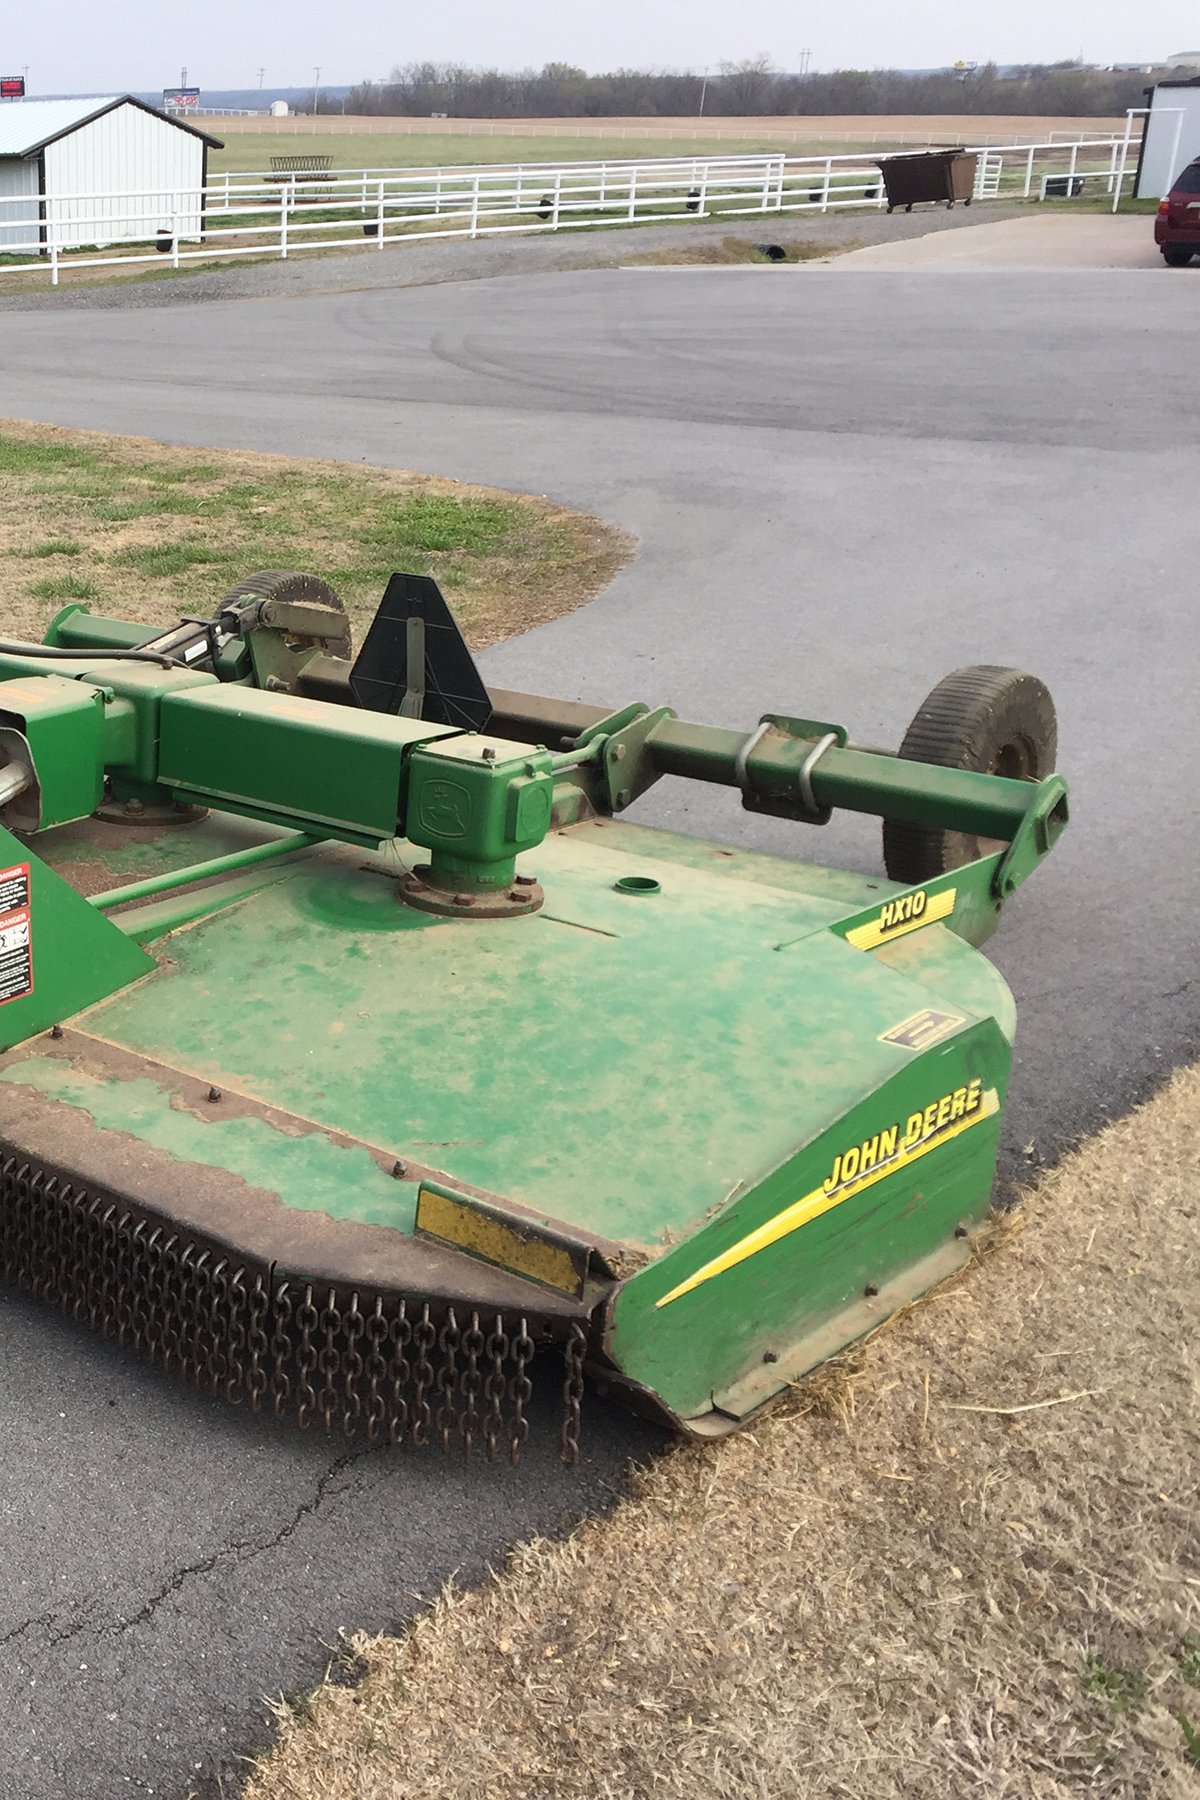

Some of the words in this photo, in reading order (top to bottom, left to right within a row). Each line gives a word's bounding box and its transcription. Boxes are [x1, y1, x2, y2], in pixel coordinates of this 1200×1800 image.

[0, 912, 27, 928] DANGER
[880, 890, 926, 930] HX10
[822, 1125, 899, 1193] JOHN
[903, 1078, 983, 1143] DEERE
